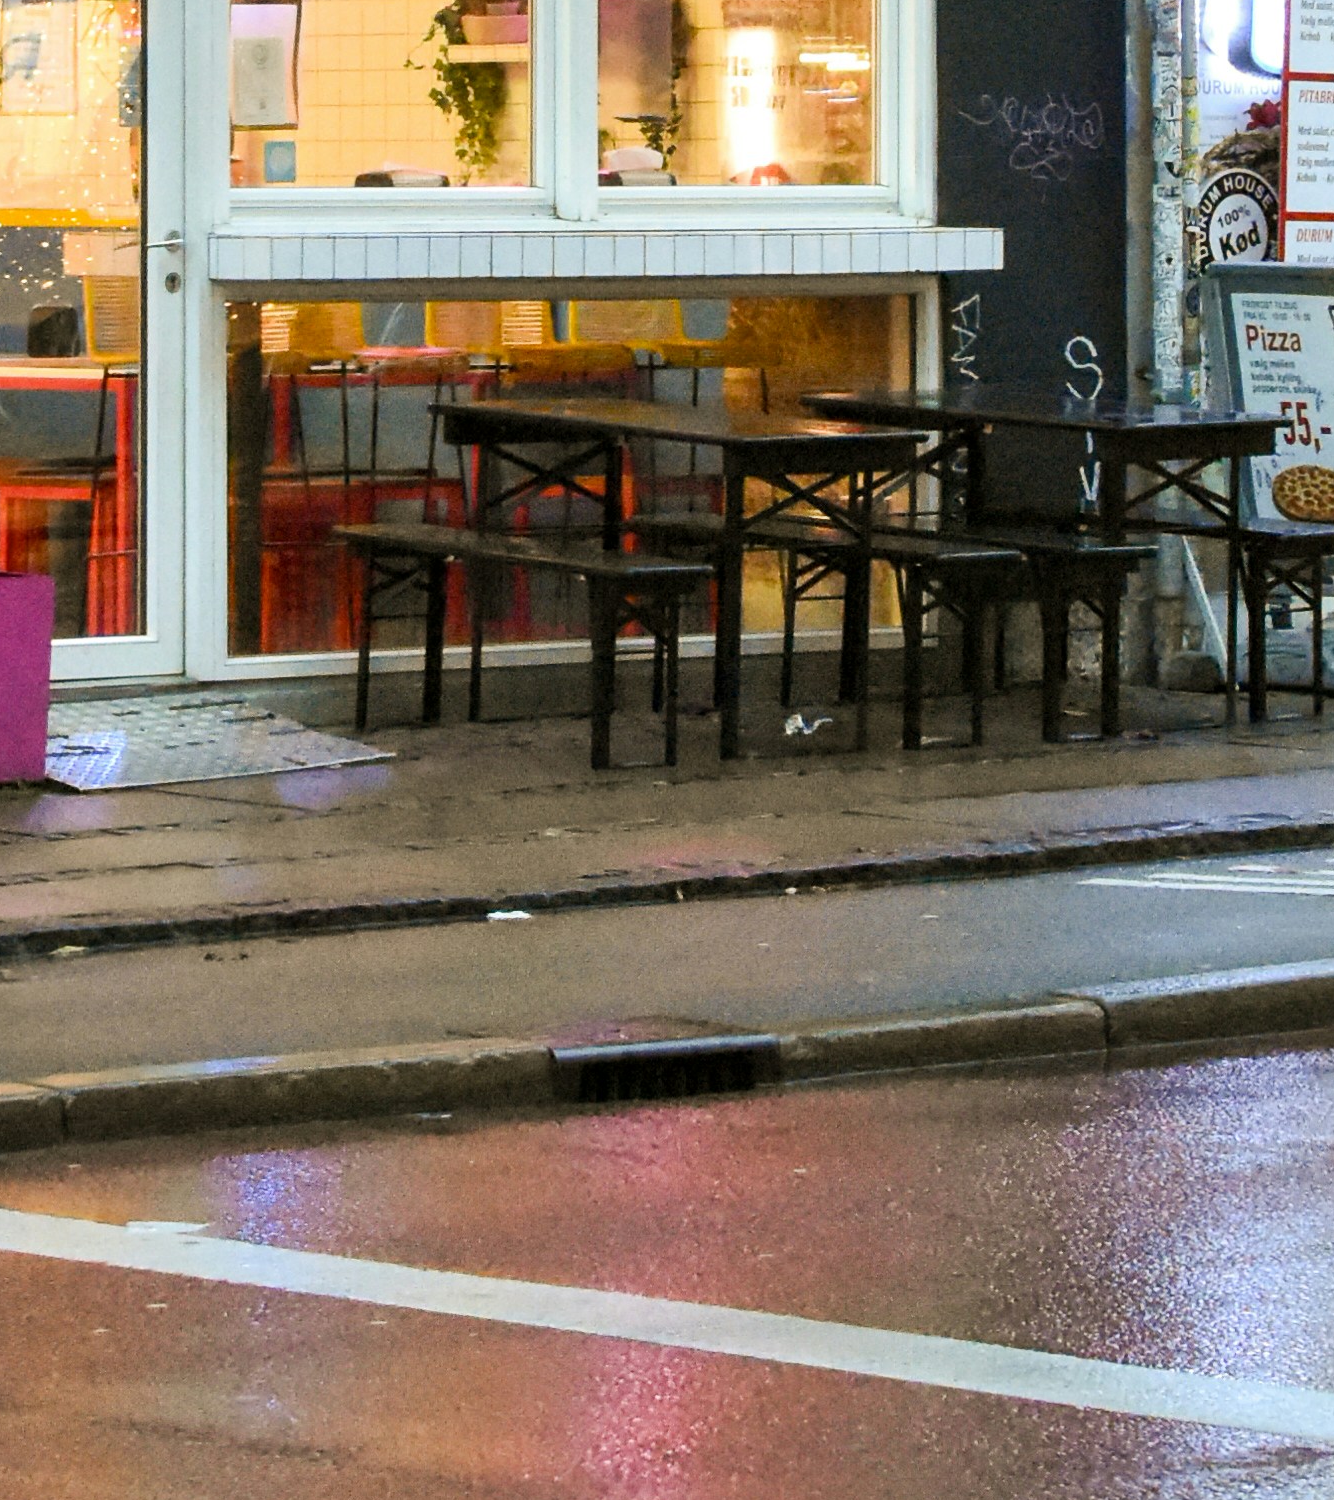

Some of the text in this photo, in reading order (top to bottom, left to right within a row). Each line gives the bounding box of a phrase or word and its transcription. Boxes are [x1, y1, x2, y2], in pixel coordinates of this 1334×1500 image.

[1196, 80, 1245, 95] URUM
[1217, 204, 1251, 228] 100%
[1218, 219, 1262, 261] Kød
[1296, 228, 1333, 243] DURUM
[1245, 323, 1302, 352] Pizza
